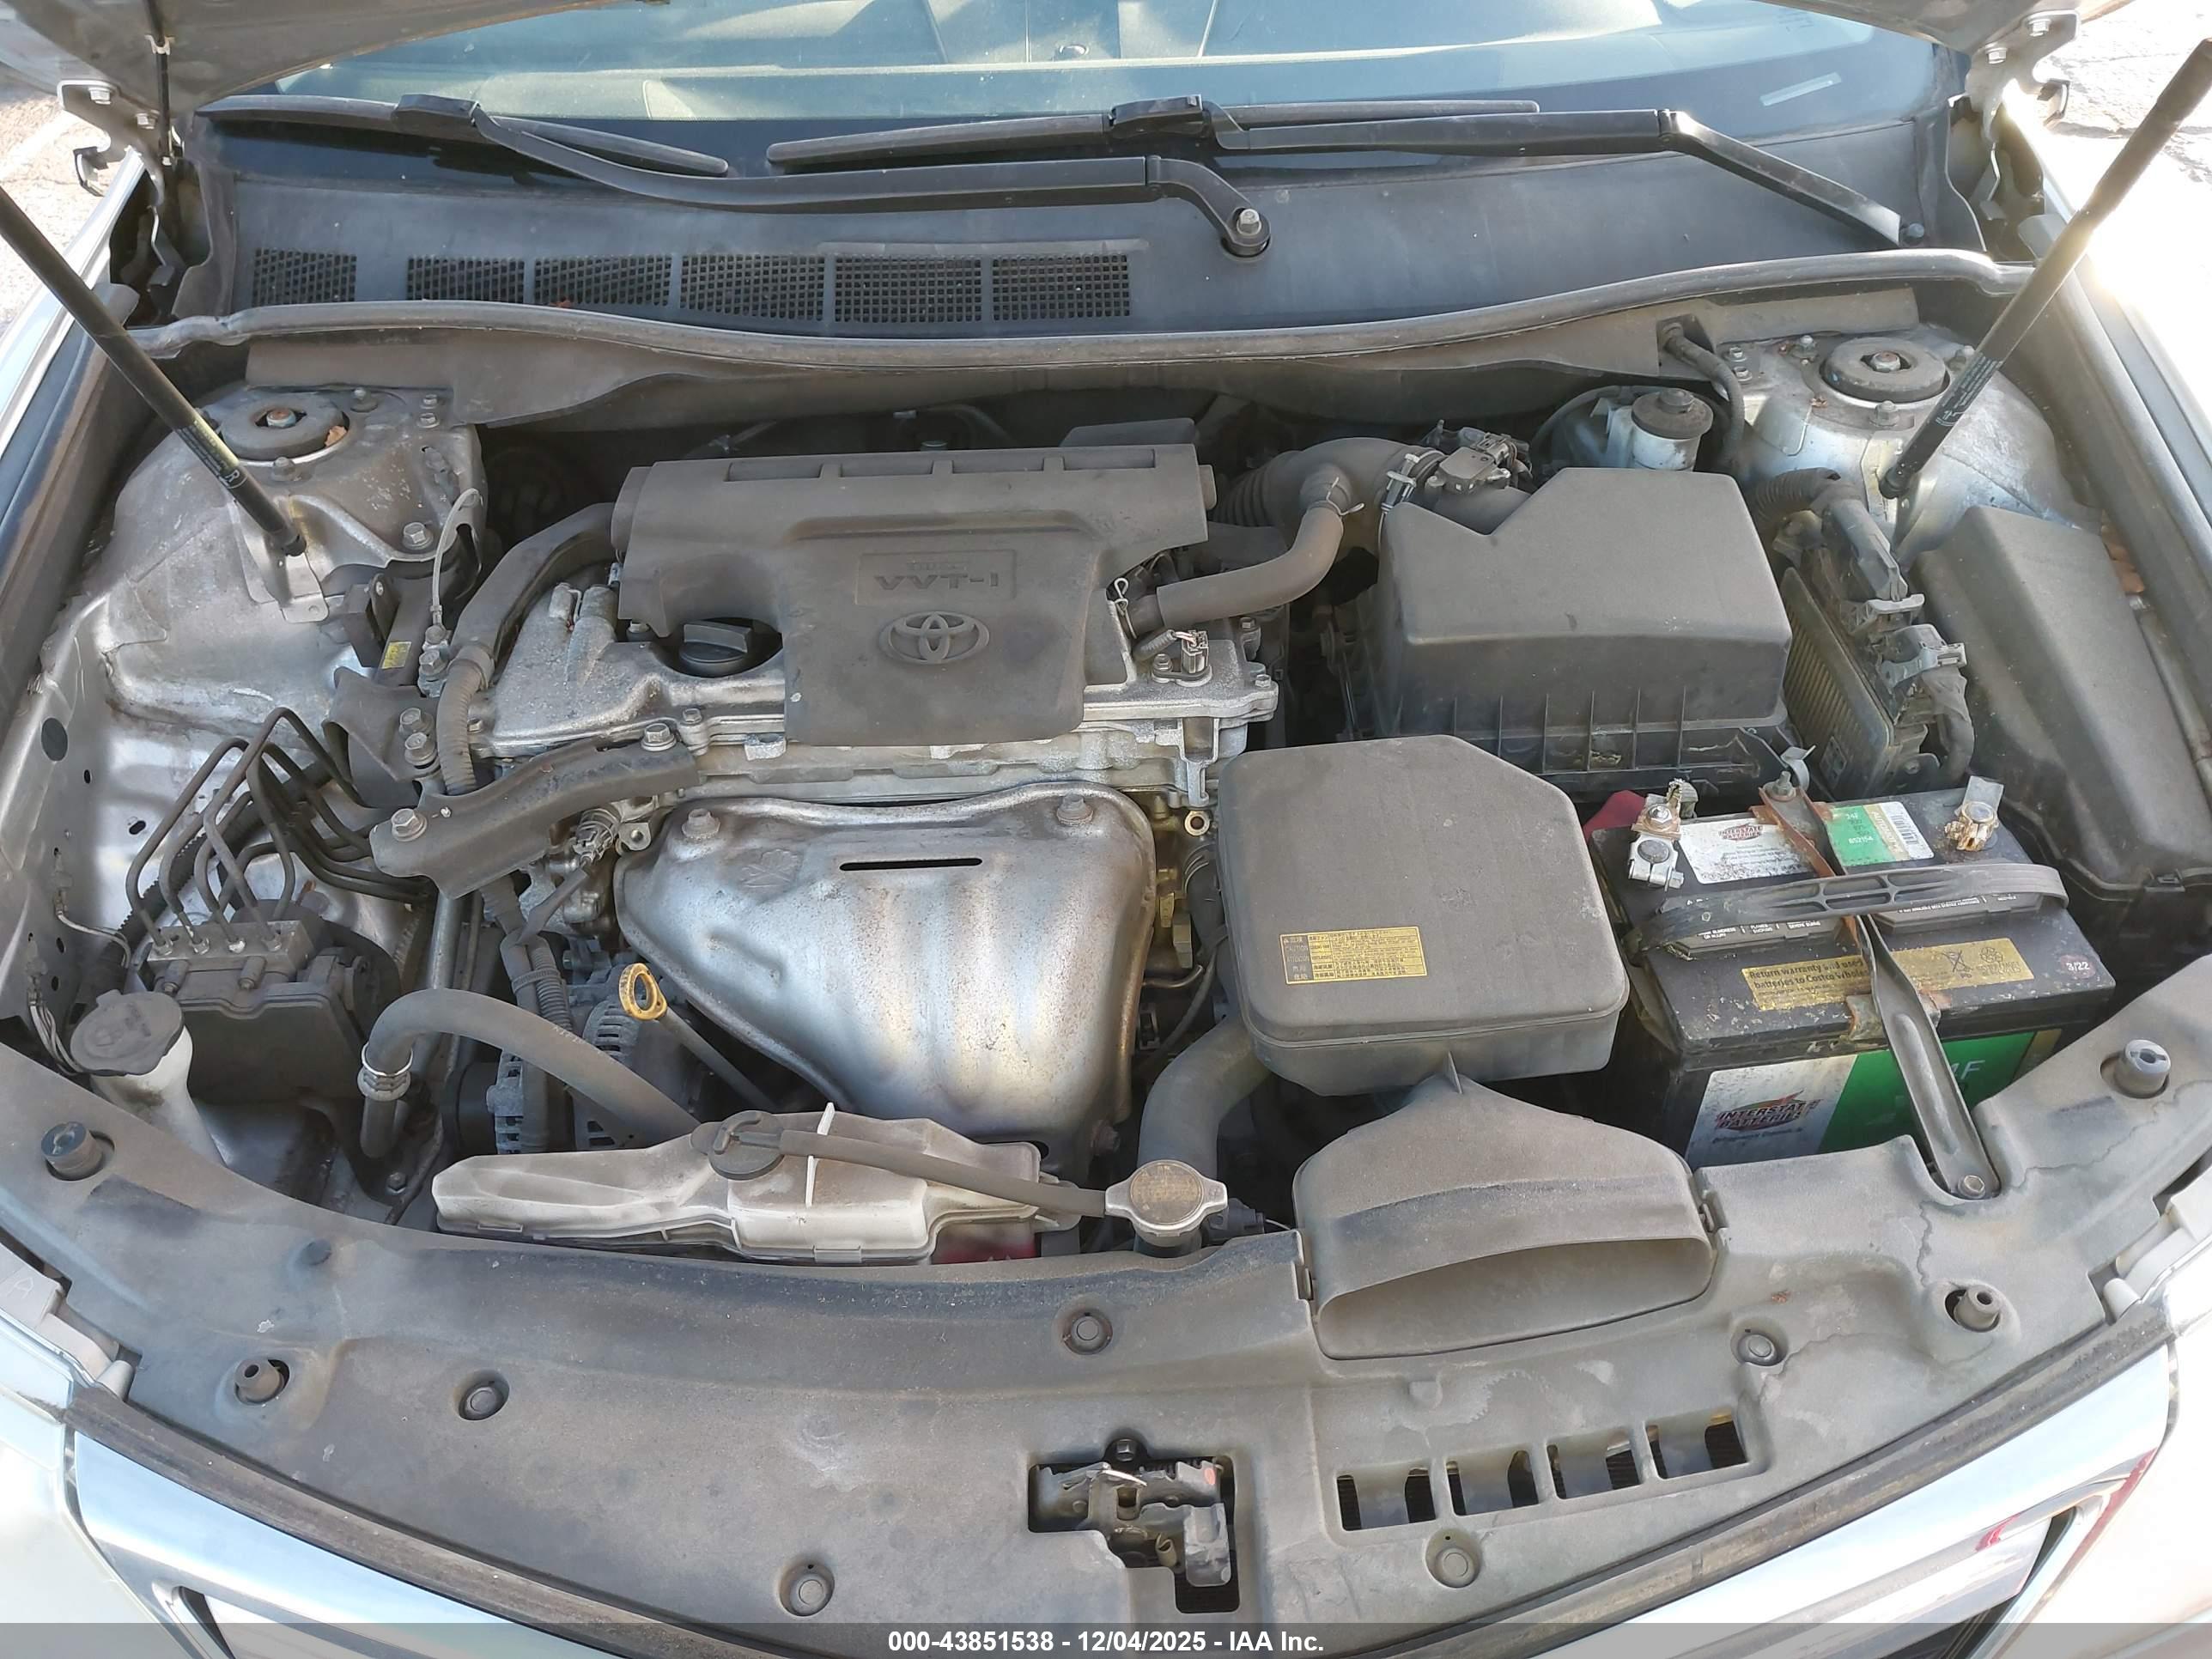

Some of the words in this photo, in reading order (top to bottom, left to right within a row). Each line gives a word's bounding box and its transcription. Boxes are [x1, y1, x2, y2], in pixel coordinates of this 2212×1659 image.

[1717, 824, 1764, 836] INTERSTATE
[1749, 969, 1782, 980] Return
[1781, 963, 1822, 976] warranty
[2065, 961, 2090, 972] 3/22
[1753, 976, 1795, 990] batteries
[1794, 976, 1806, 985] to
[1806, 973, 1836, 984] Costco
